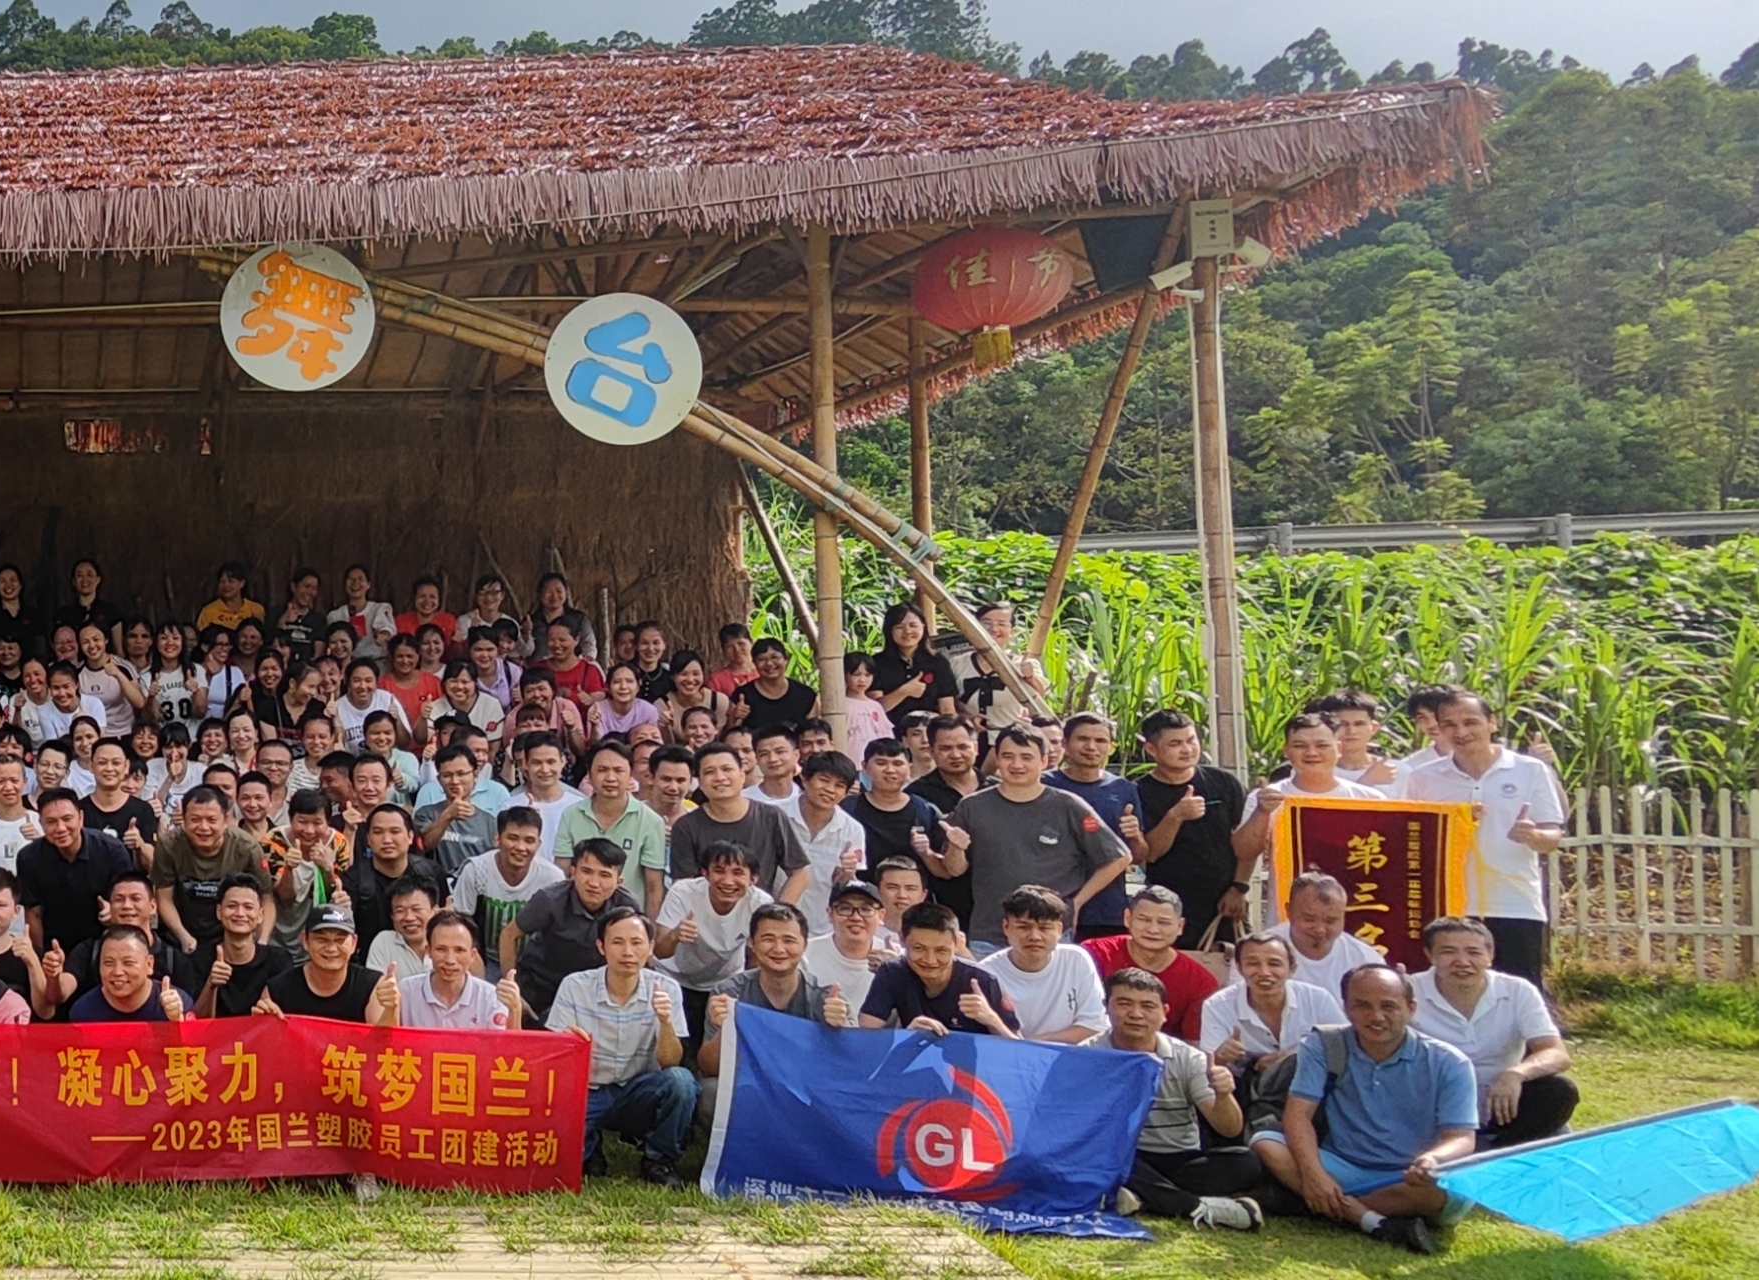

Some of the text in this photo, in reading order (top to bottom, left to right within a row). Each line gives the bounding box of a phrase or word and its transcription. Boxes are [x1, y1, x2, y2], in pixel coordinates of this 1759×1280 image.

[236, 250, 363, 381] 舞
[565, 311, 672, 426] 台
[161, 698, 191, 721] 30
[915, 1123, 994, 1171] GL
